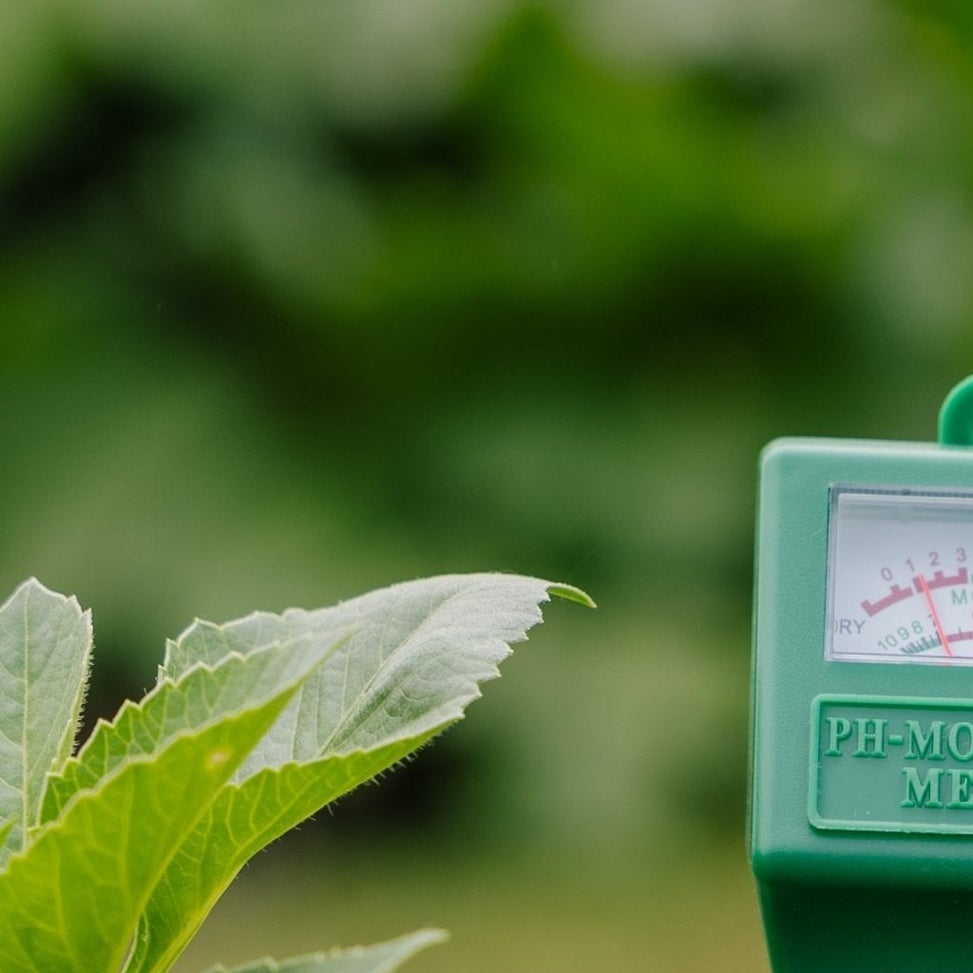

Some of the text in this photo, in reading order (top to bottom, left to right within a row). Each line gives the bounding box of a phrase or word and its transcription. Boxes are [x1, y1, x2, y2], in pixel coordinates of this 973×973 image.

[880, 567, 893, 581] 0
[905, 558, 915, 572] 1
[928, 551, 941, 567] 2
[955, 548, 967, 562] 3
[834, 618, 866, 635] RY
[877, 634, 898, 651] 10
[897, 626, 910, 640] 9
[911, 620, 924, 634] 8
